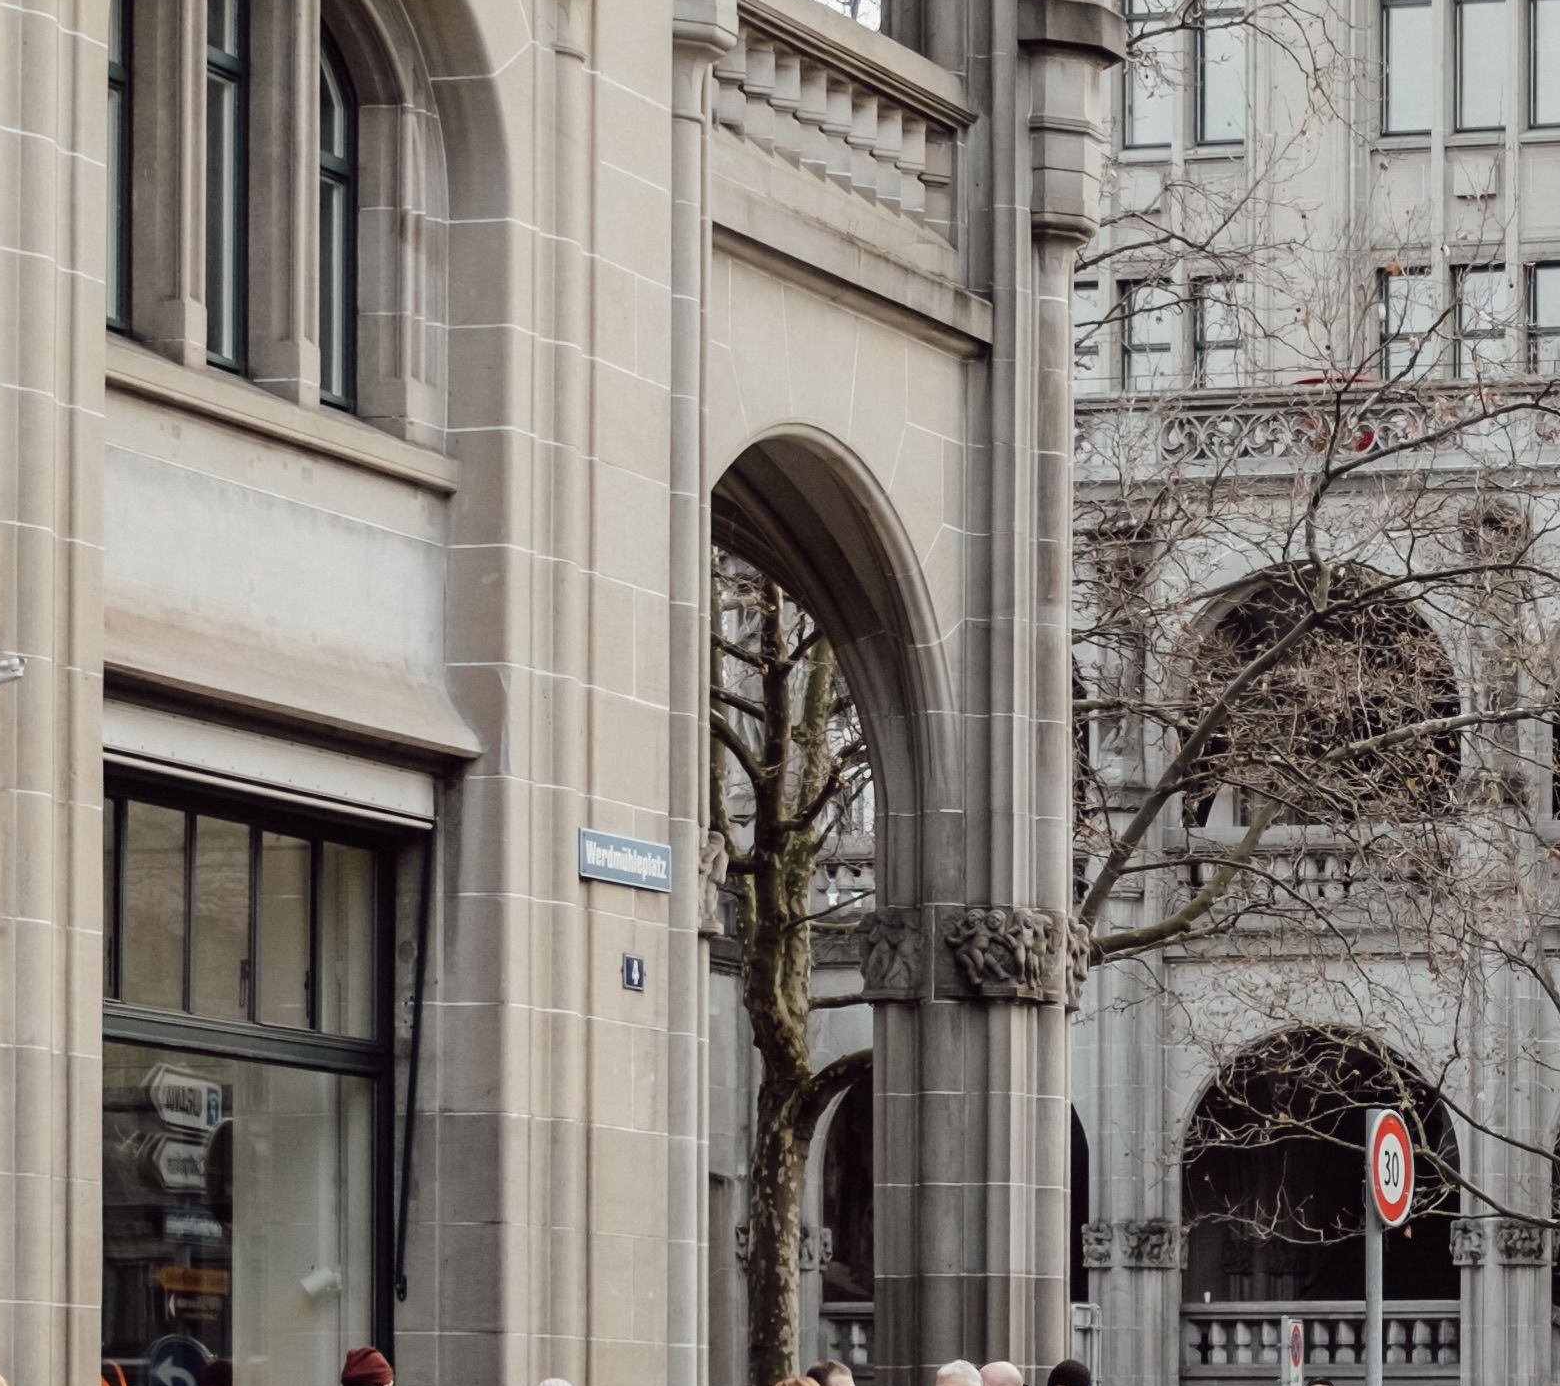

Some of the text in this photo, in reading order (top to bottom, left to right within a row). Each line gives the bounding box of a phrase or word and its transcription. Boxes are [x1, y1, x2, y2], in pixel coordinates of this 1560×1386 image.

[585, 840, 667, 881] Werdmühleplatz
[631, 959, 640, 986] 4
[1384, 1150, 1399, 1188] 30
